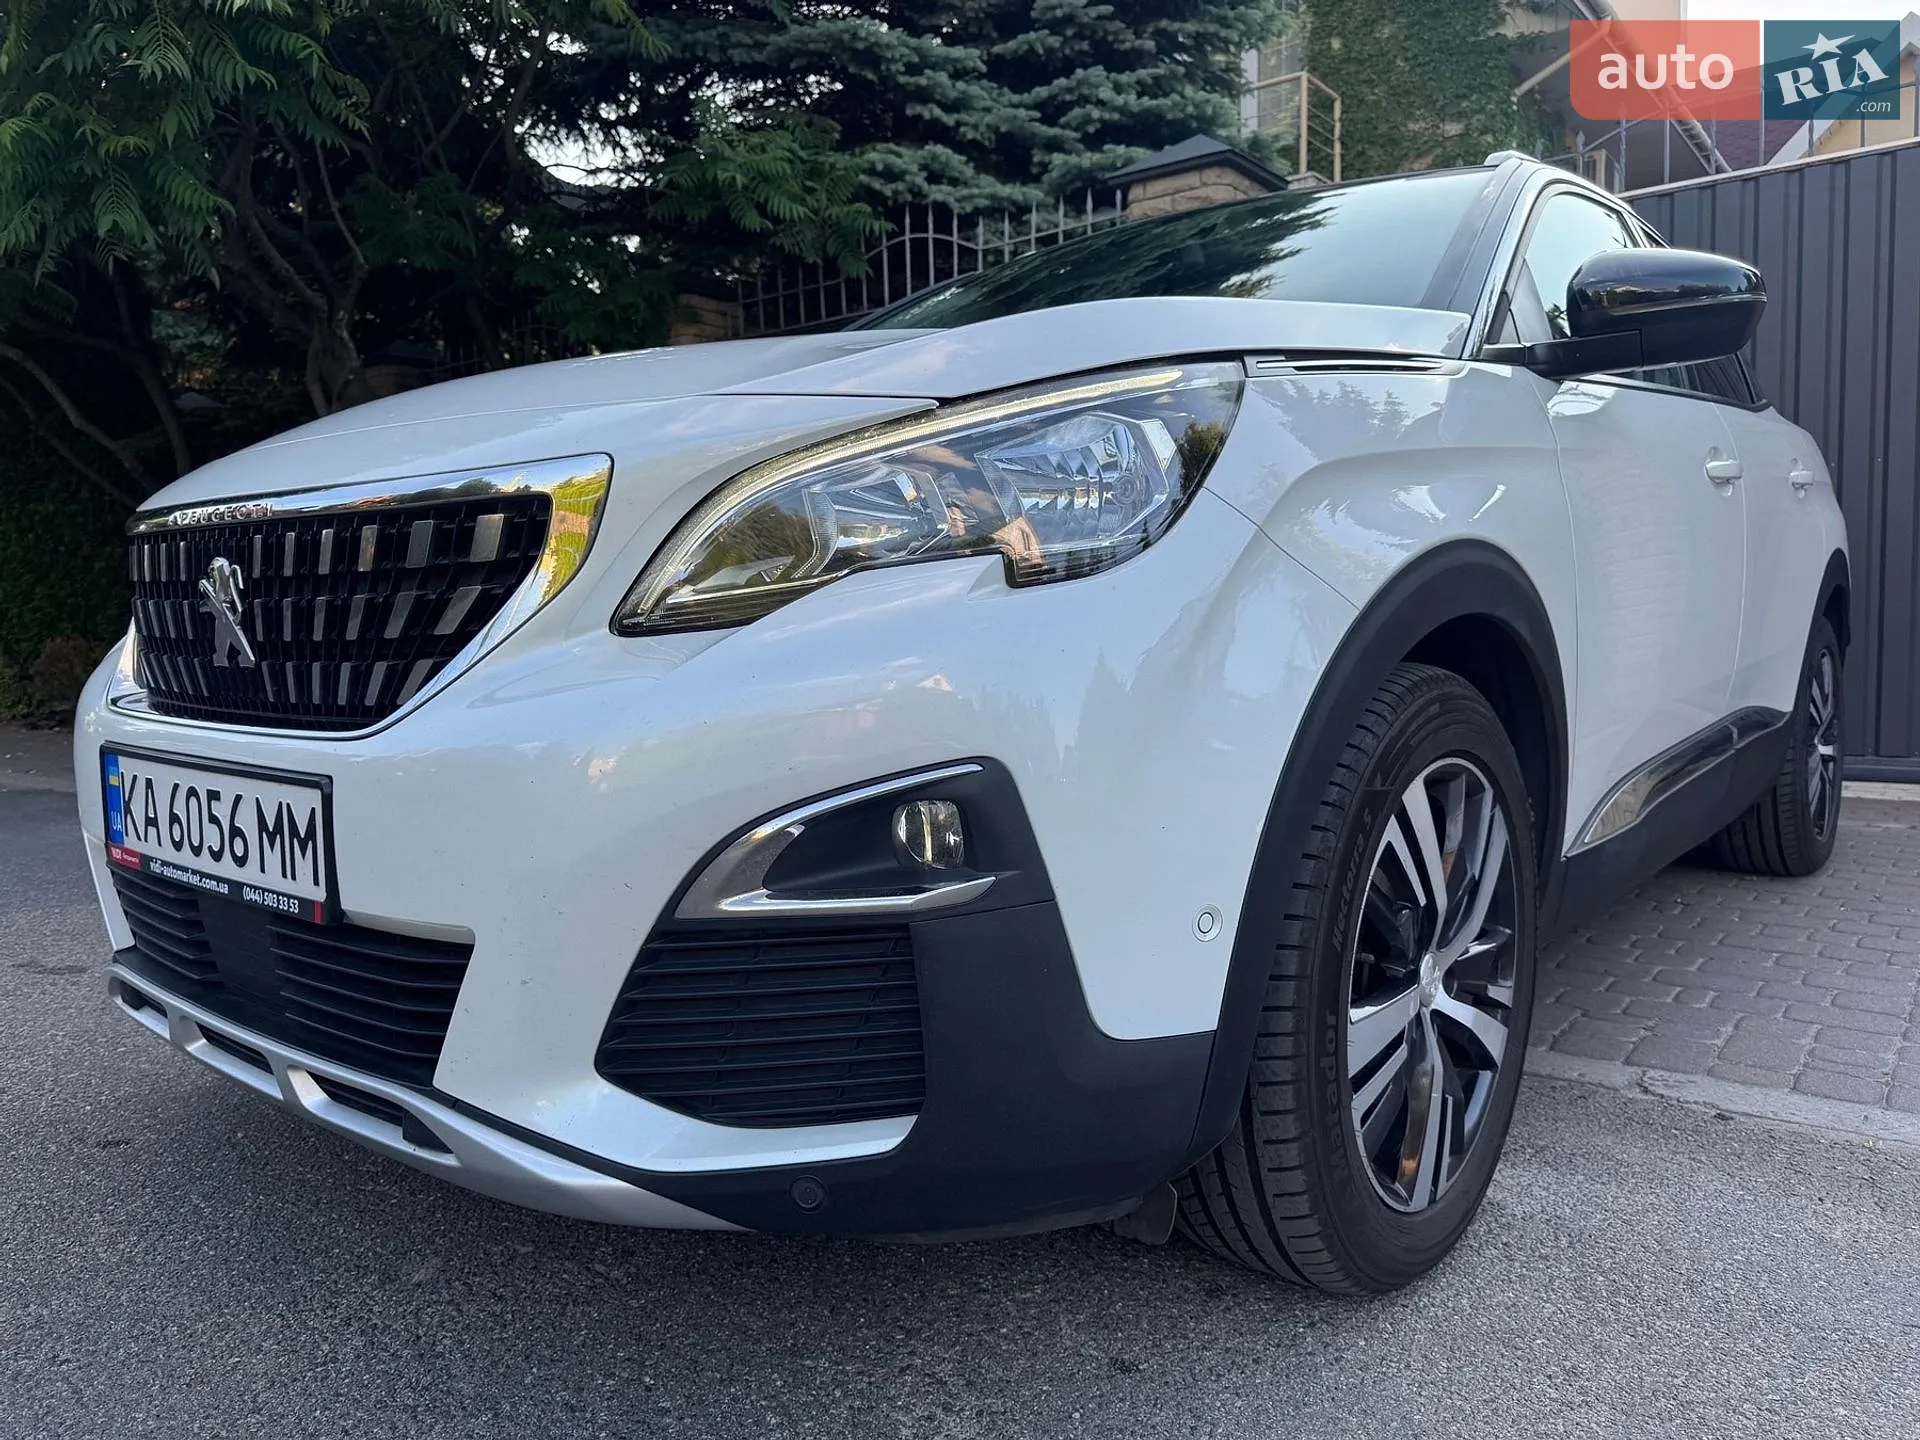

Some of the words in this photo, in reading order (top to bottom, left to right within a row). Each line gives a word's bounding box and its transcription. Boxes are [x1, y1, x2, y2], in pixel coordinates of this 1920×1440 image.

[177, 502, 263, 526] PEUGEOT
[111, 811, 122, 833] UA
[168, 782, 250, 869] 6056
[256, 796, 320, 887] MM
[150, 859, 229, 895] vidi-automarket.com.ua
[243, 885, 263, 905] (044)
[263, 892, 277, 908] 503
[278, 896, 289, 912] 33
[289, 899, 299, 914] 53
